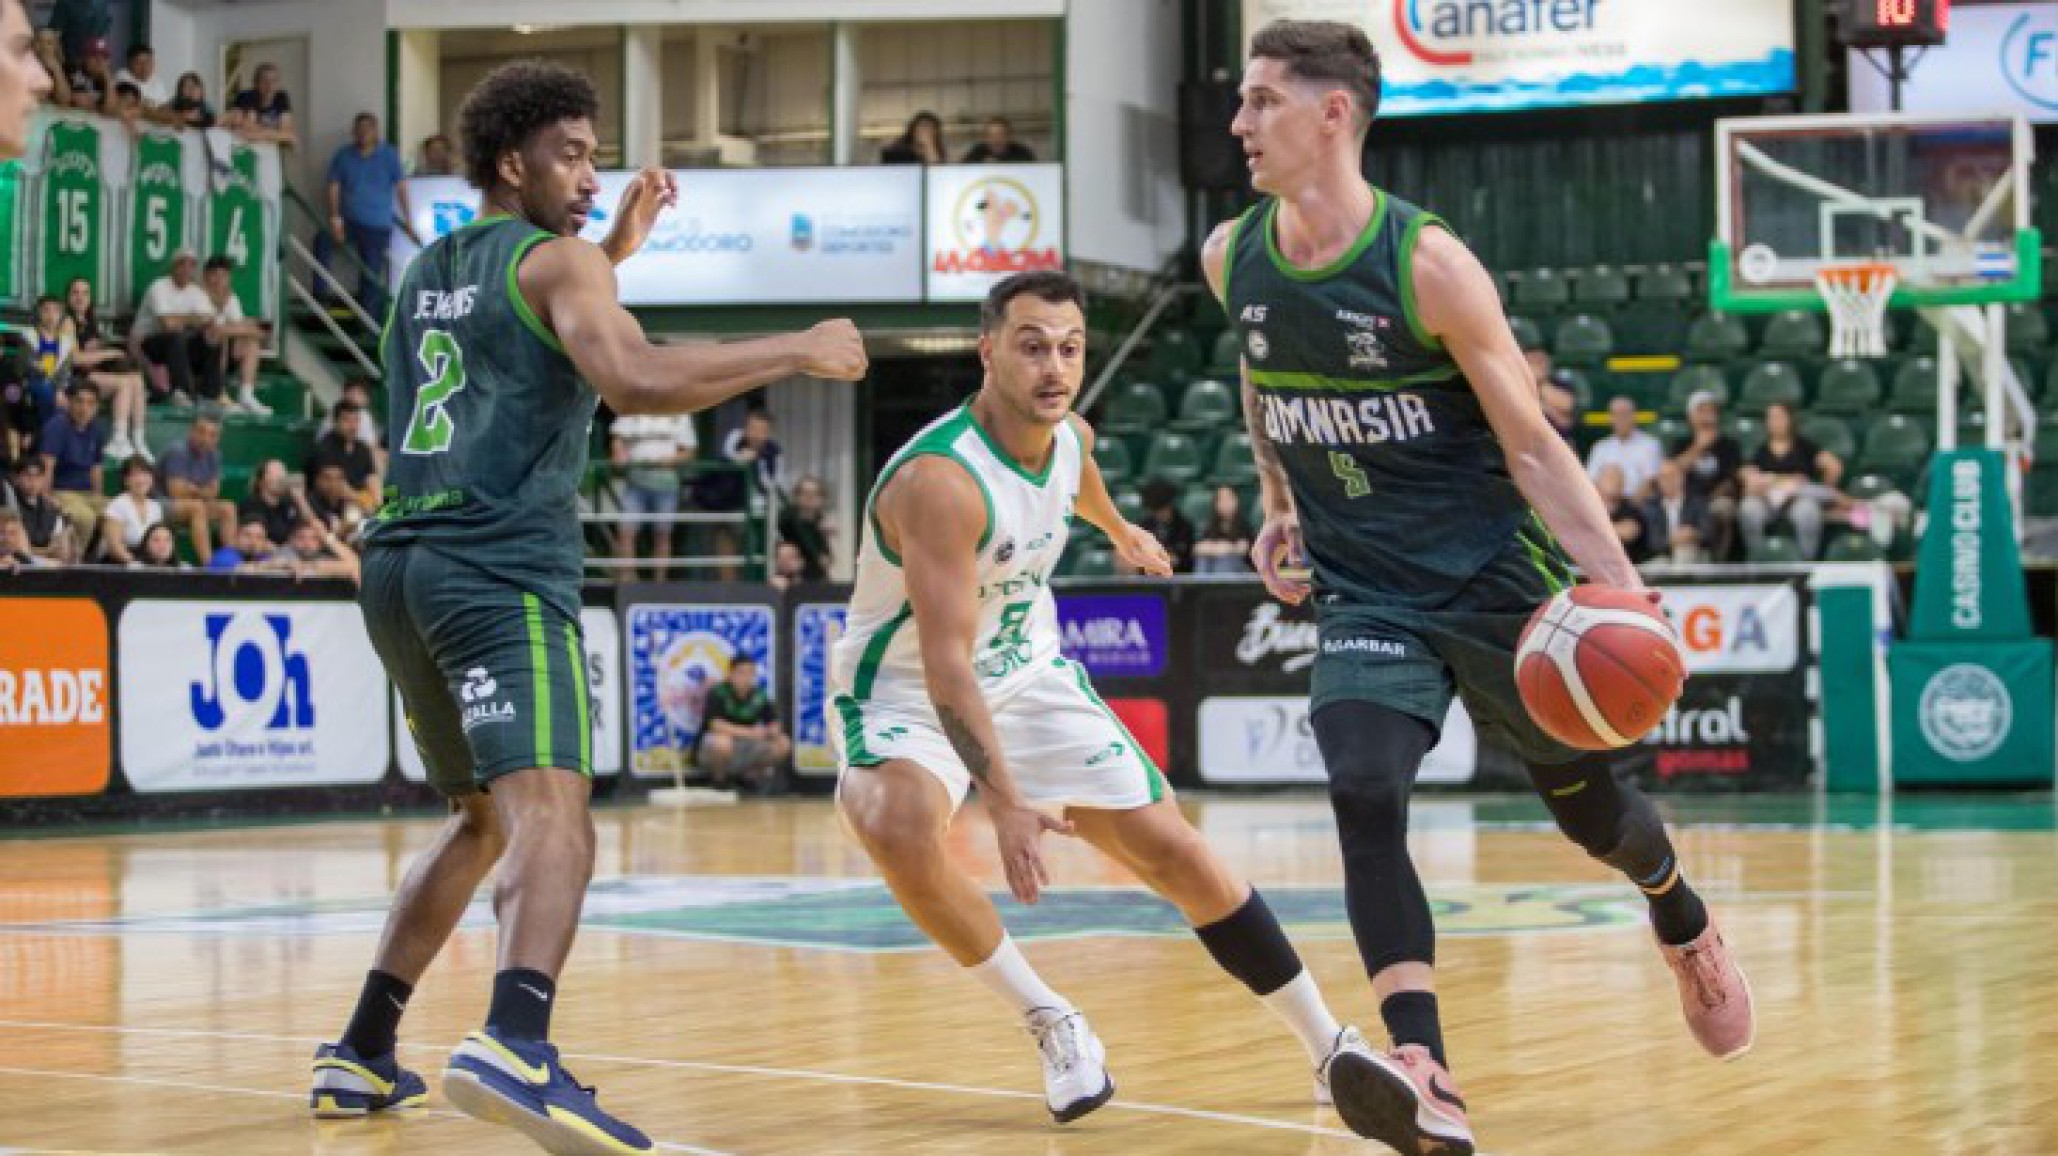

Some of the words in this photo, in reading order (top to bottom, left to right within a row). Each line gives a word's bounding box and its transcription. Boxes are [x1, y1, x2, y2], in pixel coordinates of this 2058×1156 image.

[57, 191, 89, 254] 15
[145, 196, 167, 260] 5
[225, 205, 248, 266] 4
[401, 329, 467, 456] 2
[1952, 459, 1982, 531] CLUB
[1952, 533, 1982, 629] CASINO
[0, 669, 102, 723] RADE
